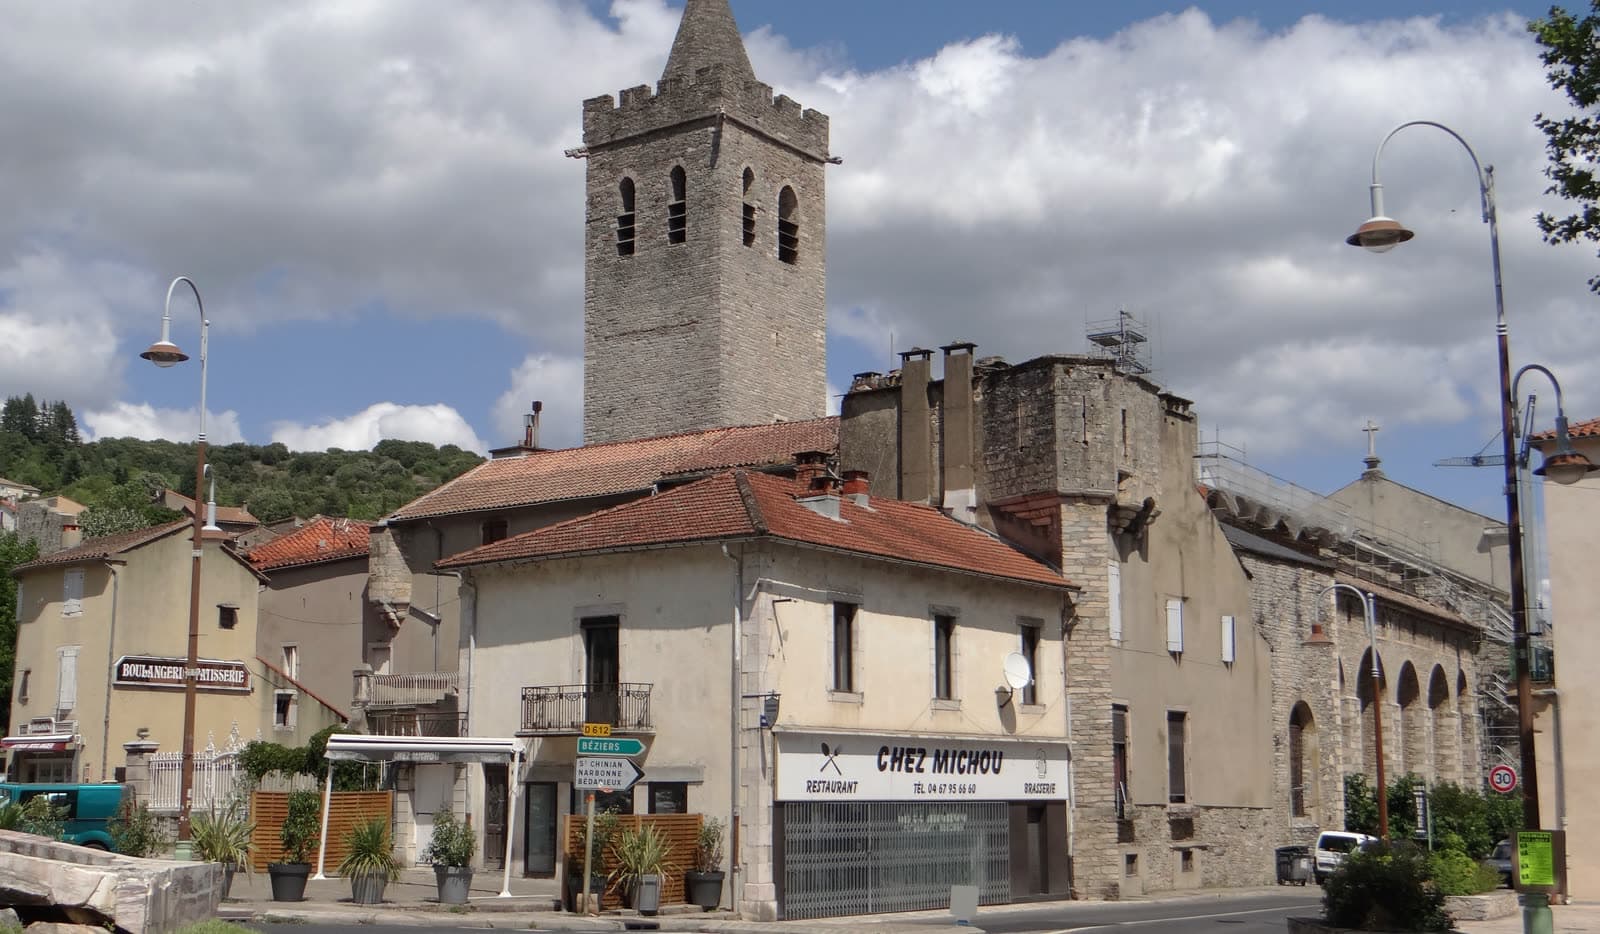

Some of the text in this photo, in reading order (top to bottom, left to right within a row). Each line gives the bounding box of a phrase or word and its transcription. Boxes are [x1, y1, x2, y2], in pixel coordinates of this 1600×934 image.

[585, 726, 609, 735] D 612
[582, 740, 620, 751] BÉZIERS
[590, 760, 623, 768] CHINIAN
[877, 746, 1003, 775] CHEZ MICHOU
[578, 769, 622, 777] NARBONNE
[1495, 772, 1511, 785] 30
[806, 780, 858, 793] RESTAURANT
[928, 783, 937, 794] 04
[939, 783, 947, 794] 67
[948, 783, 957, 794] 95
[958, 783, 967, 794] 66
[968, 783, 977, 794] 60
[1024, 782, 1056, 794] BRASSERIE
